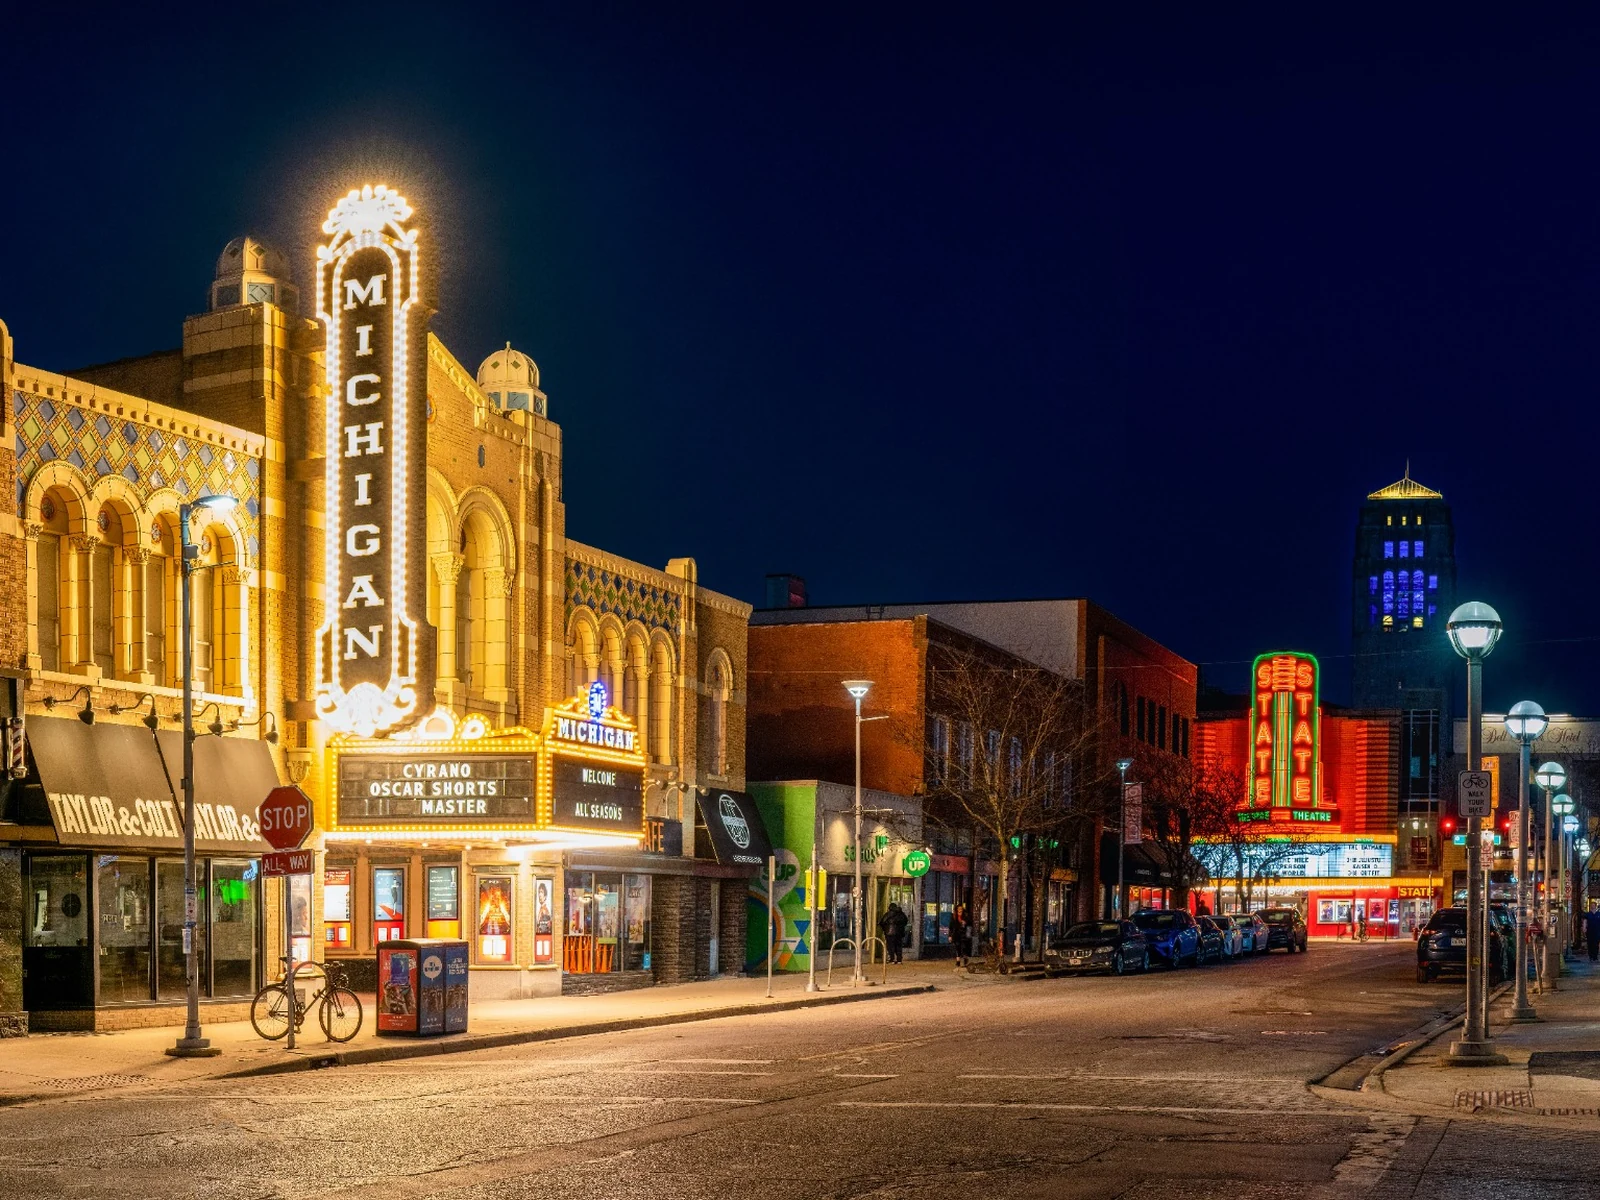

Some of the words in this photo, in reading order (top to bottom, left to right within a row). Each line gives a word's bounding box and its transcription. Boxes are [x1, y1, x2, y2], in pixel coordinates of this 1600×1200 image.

[343, 273, 387, 661] MICHIGAN
[556, 716, 635, 751] MICHIGAN
[1256, 663, 1273, 803] STATE
[1294, 663, 1314, 802] STATE
[402, 763, 472, 779] CYRANO
[582, 768, 617, 787] WELCOME
[369, 781, 425, 797] OSCAR
[431, 781, 498, 797] SHORTS
[421, 799, 487, 815] MASTER
[575, 802, 589, 818] ALL
[590, 804, 623, 821] SEASONS
[1292, 810, 1331, 822] THEATRE
[263, 805, 308, 831] STOP
[263, 856, 284, 872] ALL
[289, 854, 309, 870] WAY
[908, 861, 926, 871] UP
[1400, 888, 1434, 897] STATE
